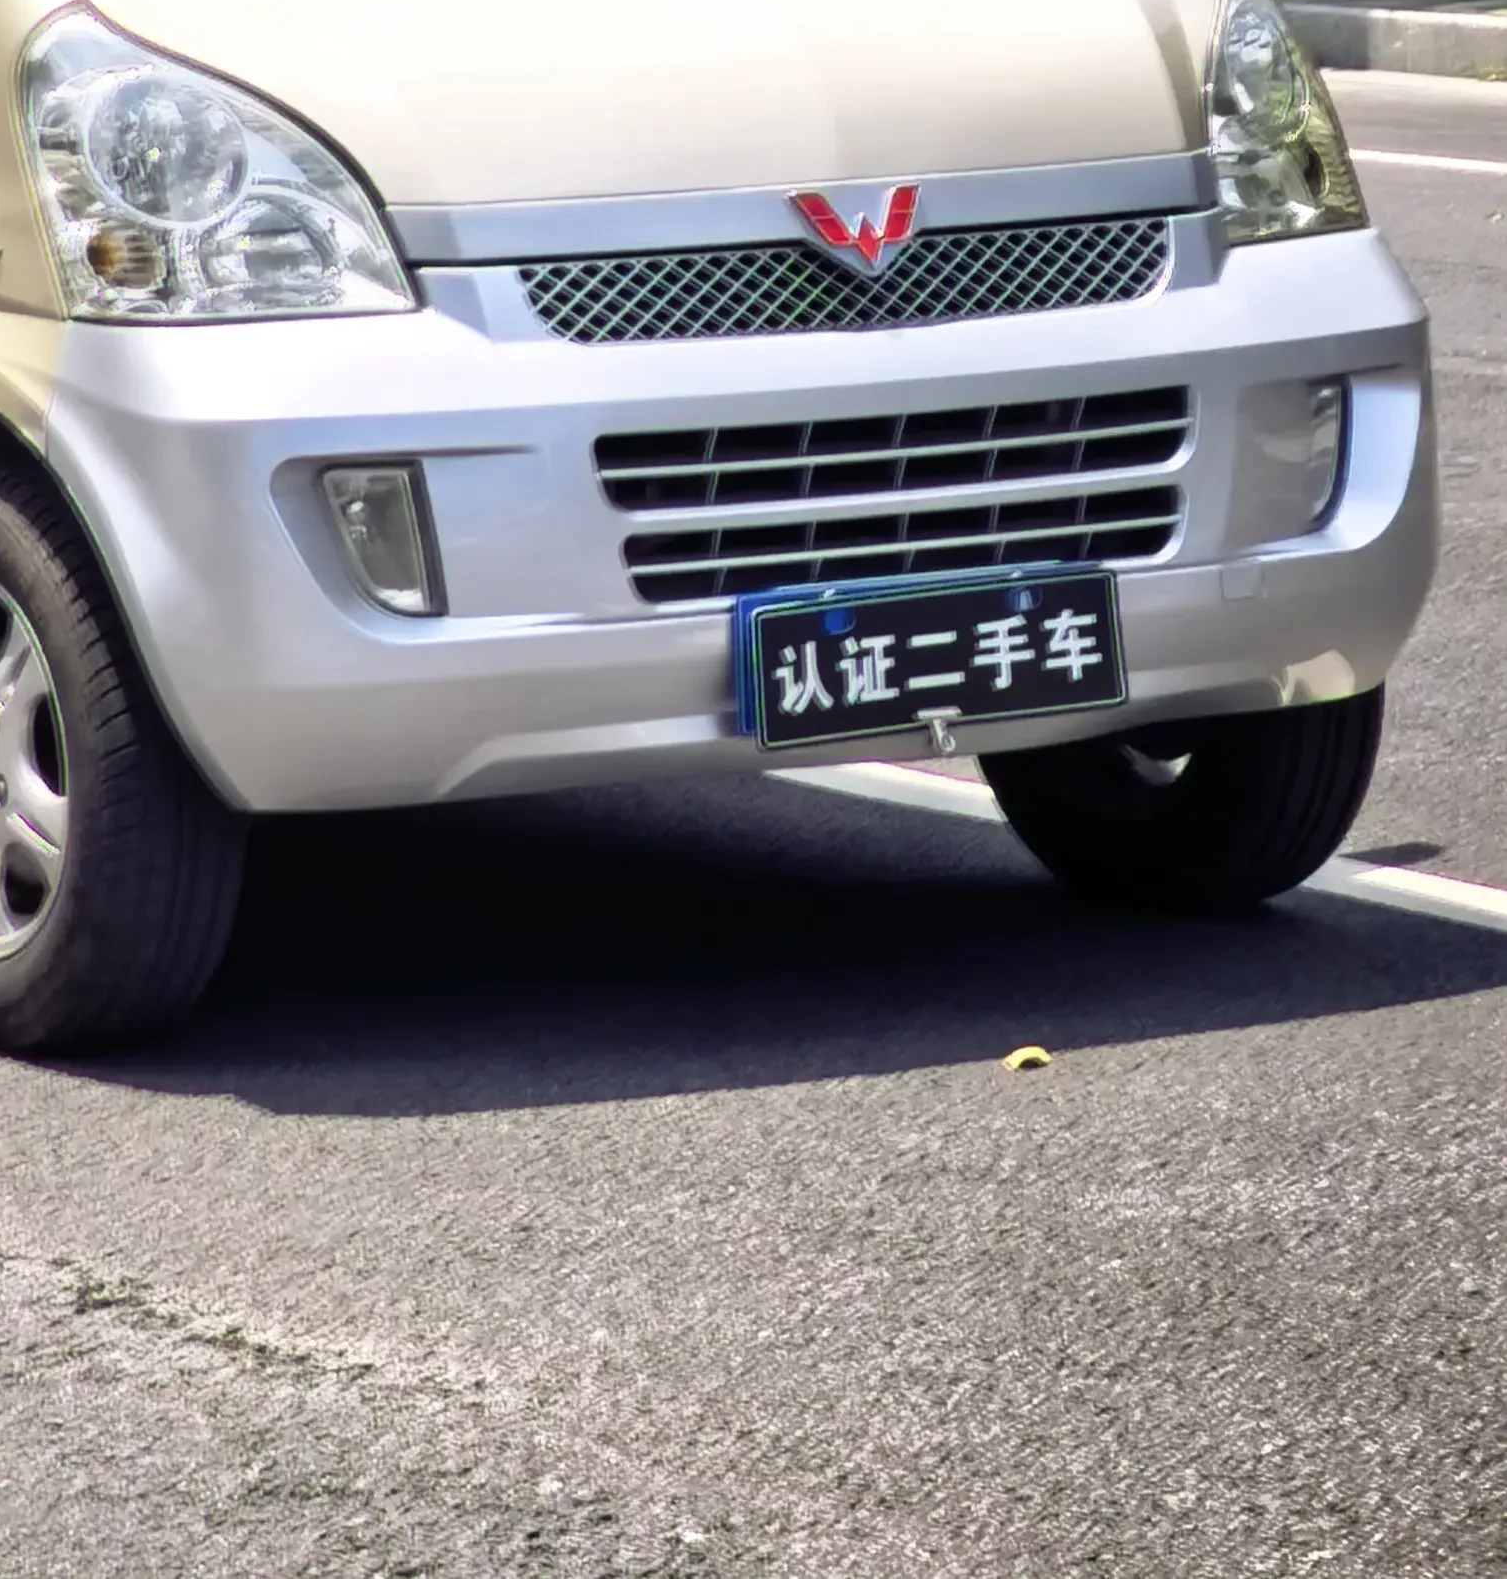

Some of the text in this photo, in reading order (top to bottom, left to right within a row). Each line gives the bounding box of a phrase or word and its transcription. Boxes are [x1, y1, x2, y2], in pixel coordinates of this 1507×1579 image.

[774, 610, 1102, 714] 认证二手车
